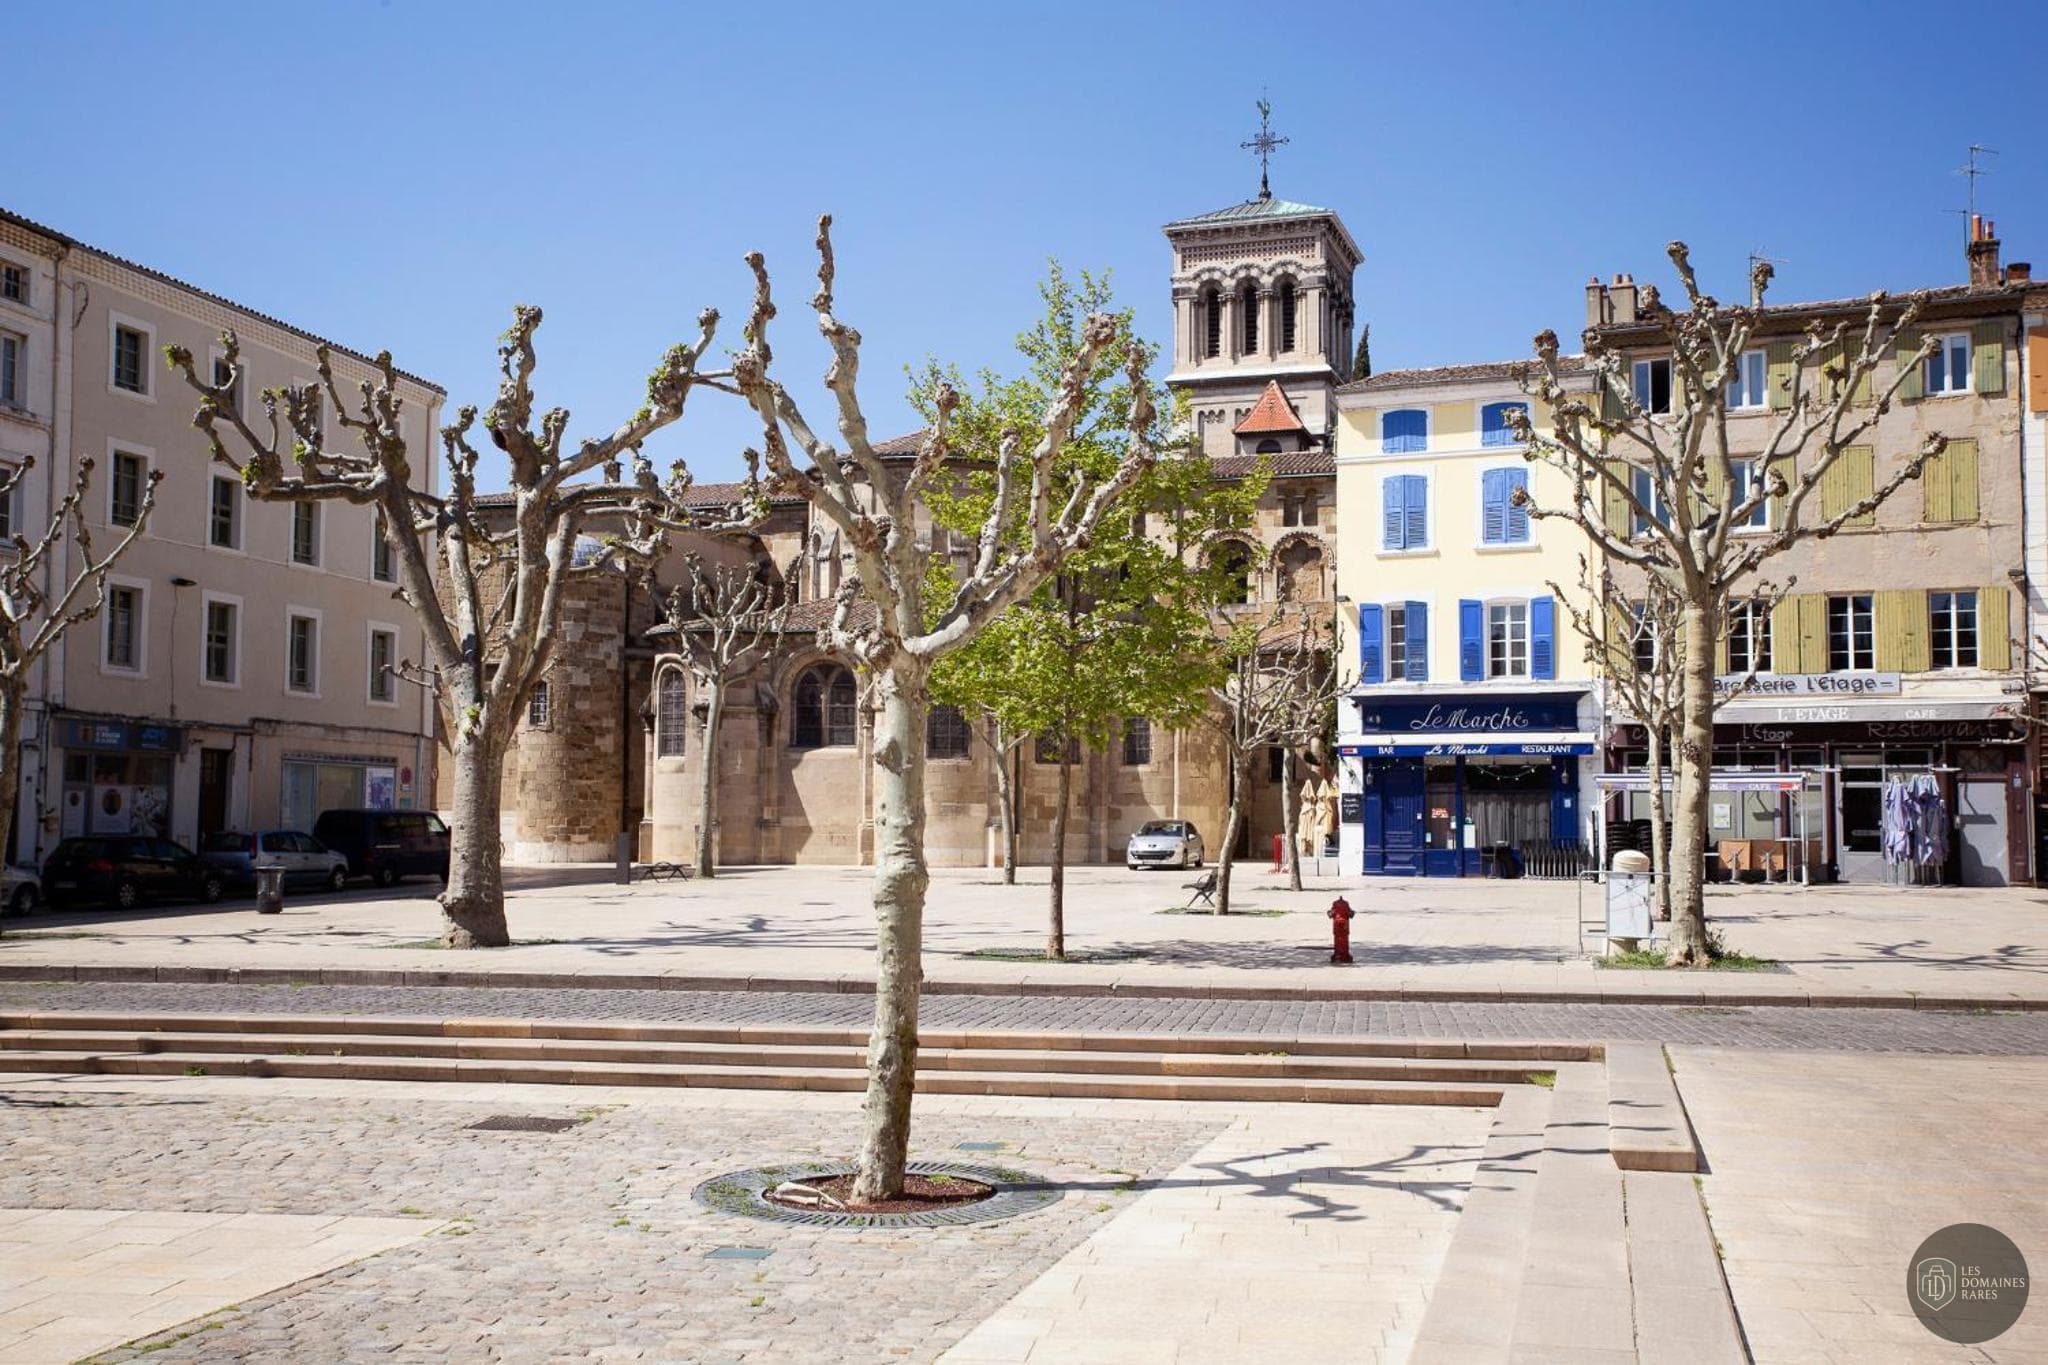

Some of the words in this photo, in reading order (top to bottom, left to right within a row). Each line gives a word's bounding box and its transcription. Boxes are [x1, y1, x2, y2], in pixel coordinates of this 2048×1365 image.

[1713, 678, 1796, 692] Braserie
[1410, 704, 1443, 729] Le
[1444, 706, 1528, 729] Marché
[1378, 746, 1394, 755] BAR
[1521, 745, 1571, 753] RESTAURANT
